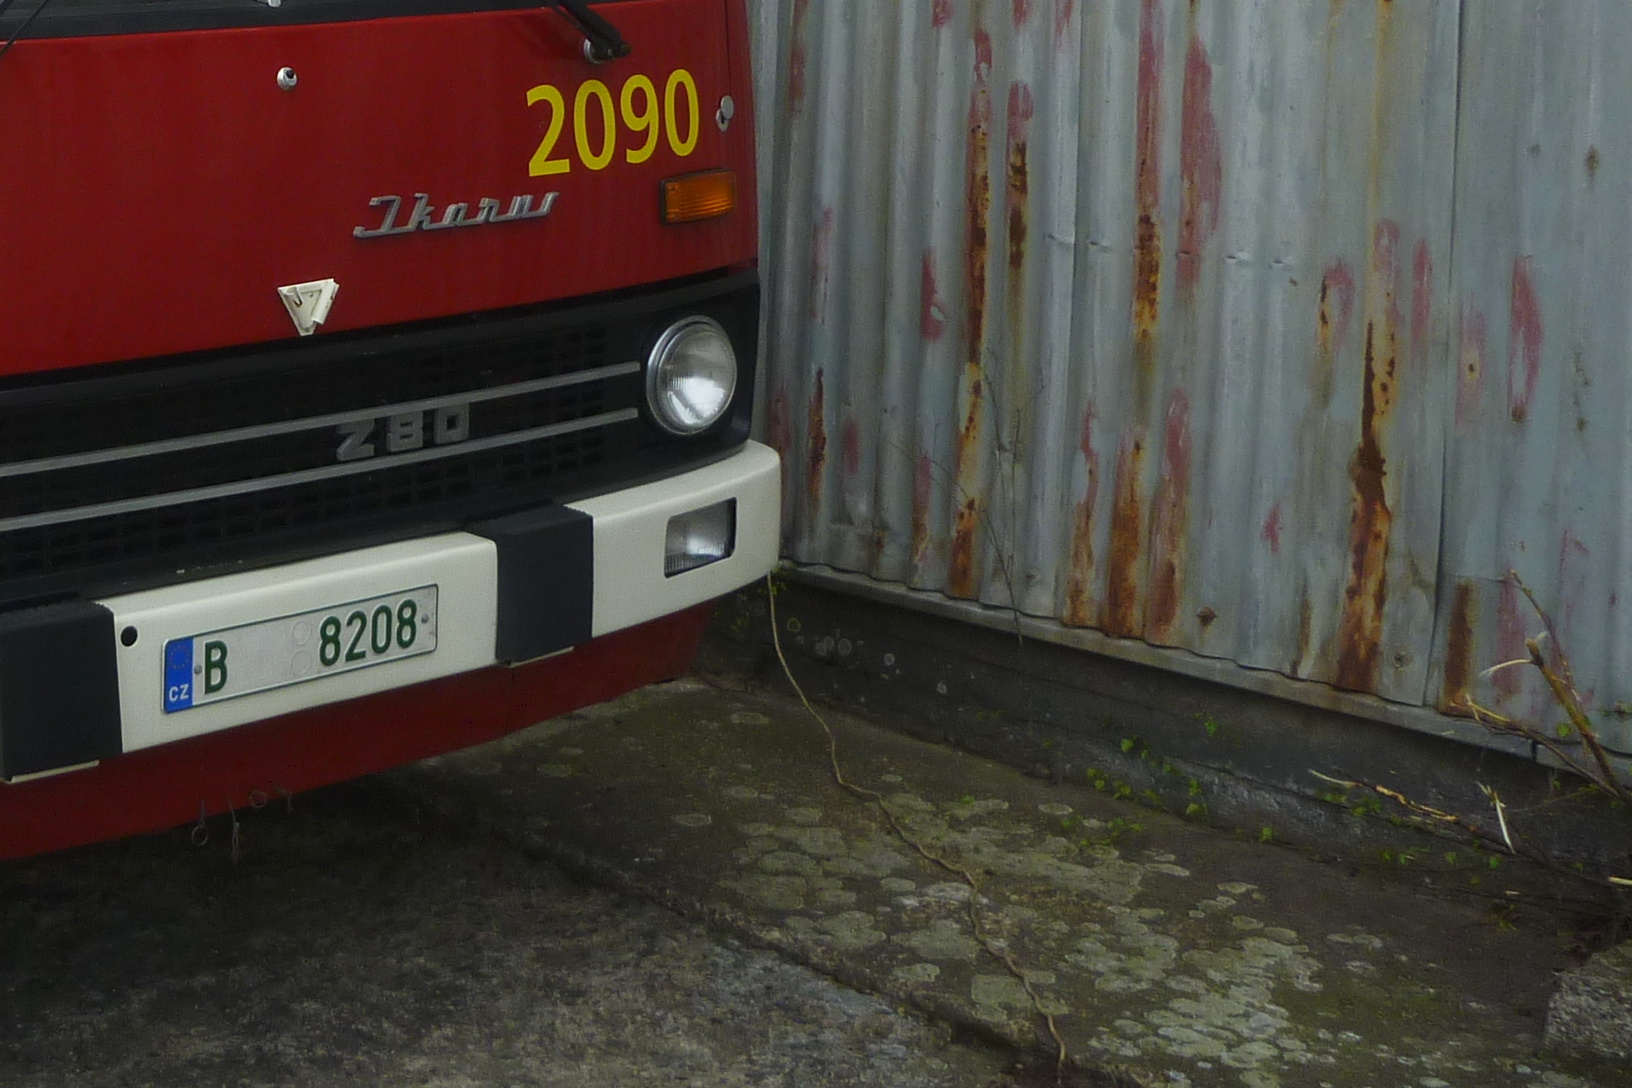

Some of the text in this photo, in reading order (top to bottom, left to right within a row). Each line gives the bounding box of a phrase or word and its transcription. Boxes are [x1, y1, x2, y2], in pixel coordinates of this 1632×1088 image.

[525, 68, 701, 177] 2090
[352, 191, 560, 240] Ikarus
[204, 598, 418, 695] B 8208
[169, 682, 189, 702] CZ
